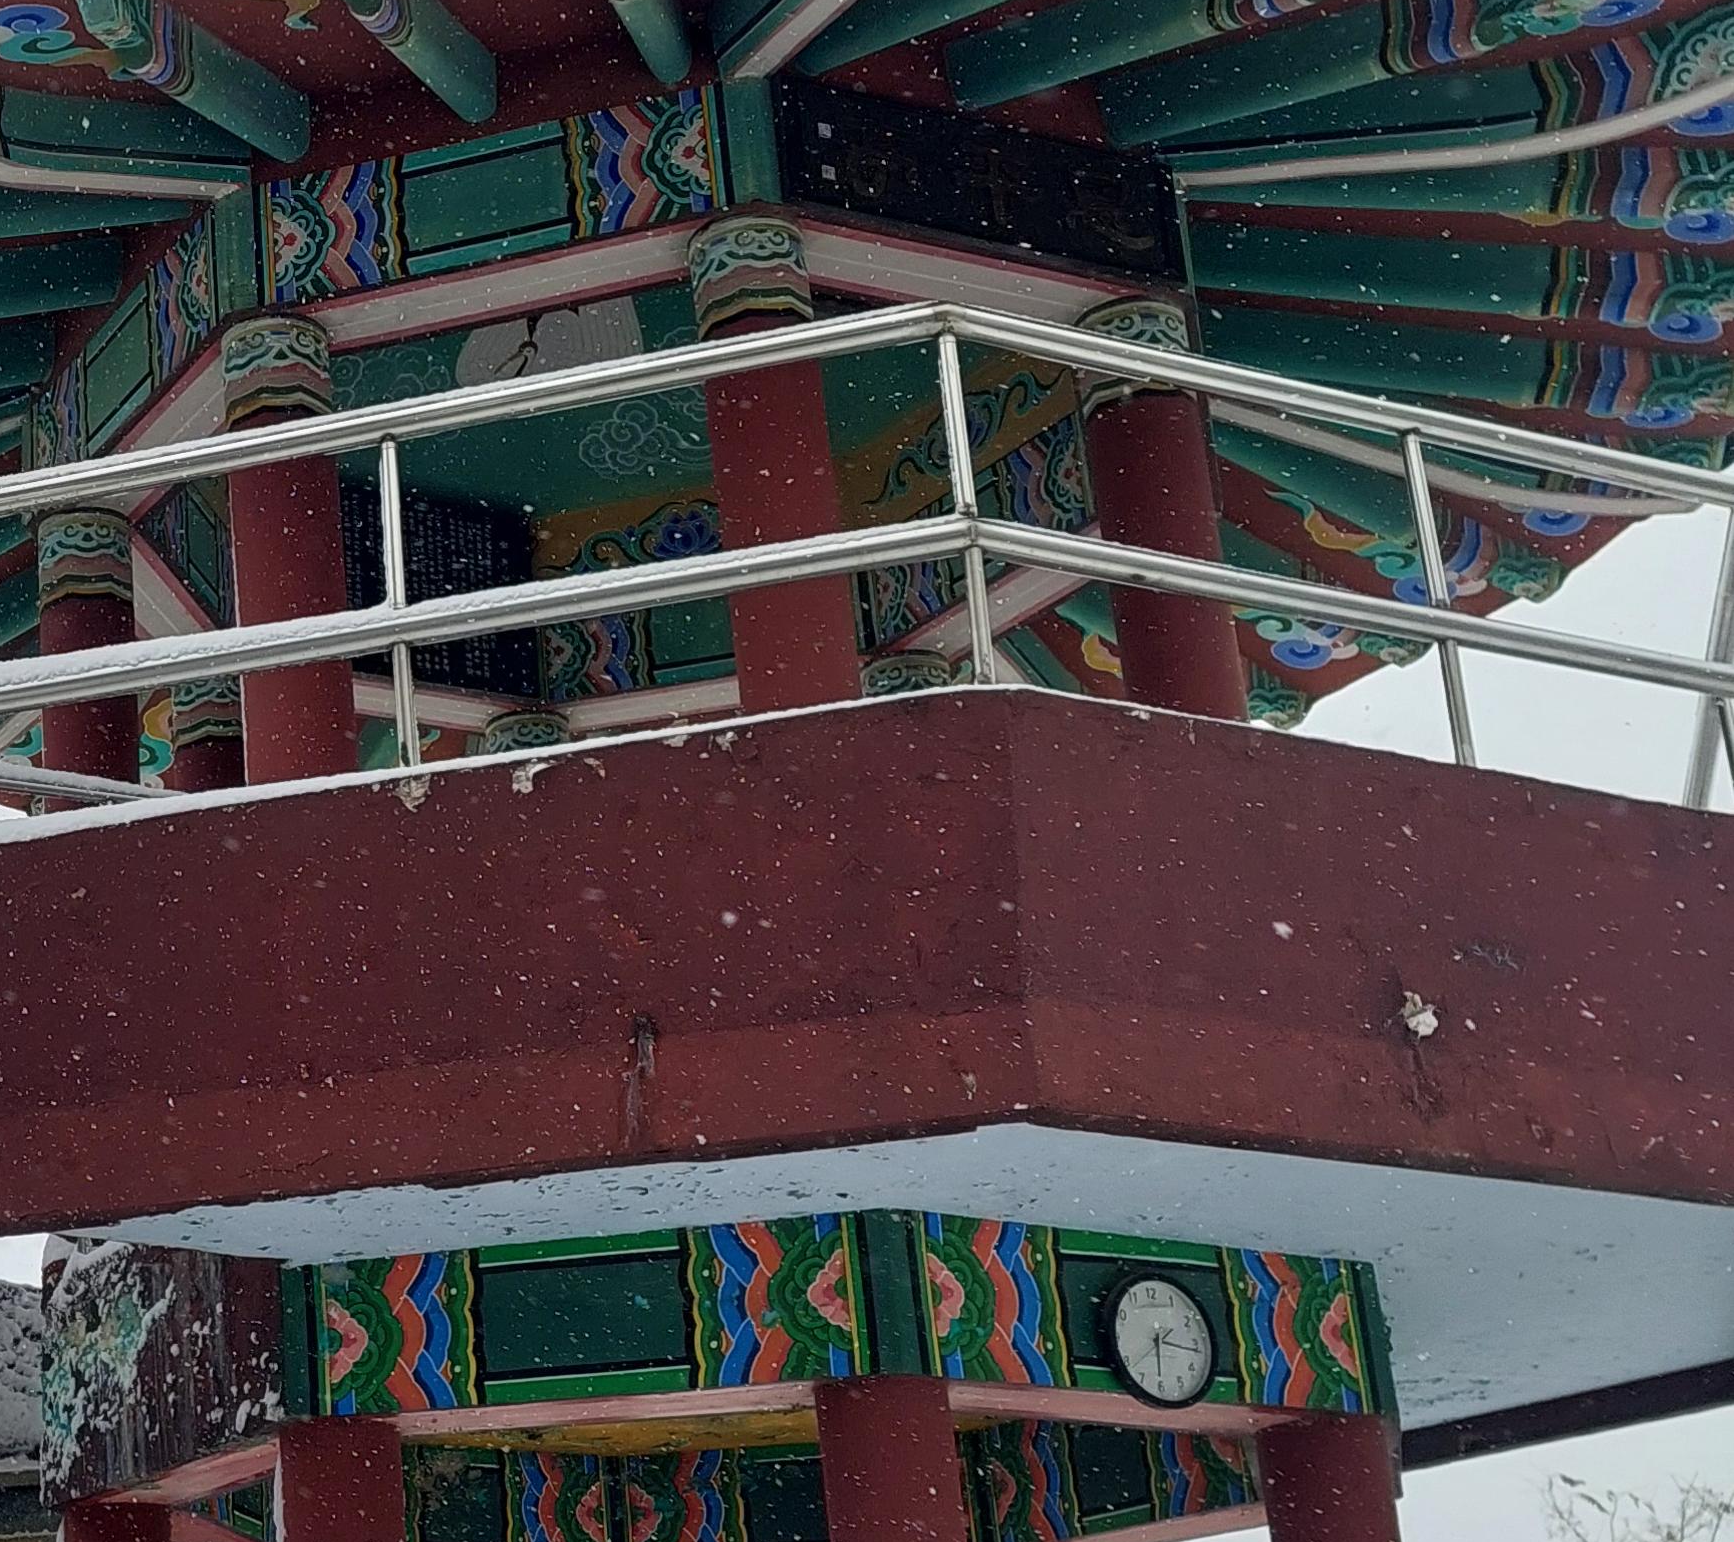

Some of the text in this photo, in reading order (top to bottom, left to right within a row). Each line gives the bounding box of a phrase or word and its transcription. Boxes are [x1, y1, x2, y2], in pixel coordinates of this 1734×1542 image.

[1128, 1292, 1137, 1304] 11
[1146, 1287, 1156, 1300] 12
[1168, 1294, 1174, 1307] 1
[1184, 1315, 1191, 1328] 2
[1192, 1338, 1199, 1351] 3
[1188, 1362, 1195, 1372] 4
[1139, 1372, 1145, 1384] 7
[1176, 1376, 1184, 1389] 5
[1157, 1381, 1165, 1393] 6
